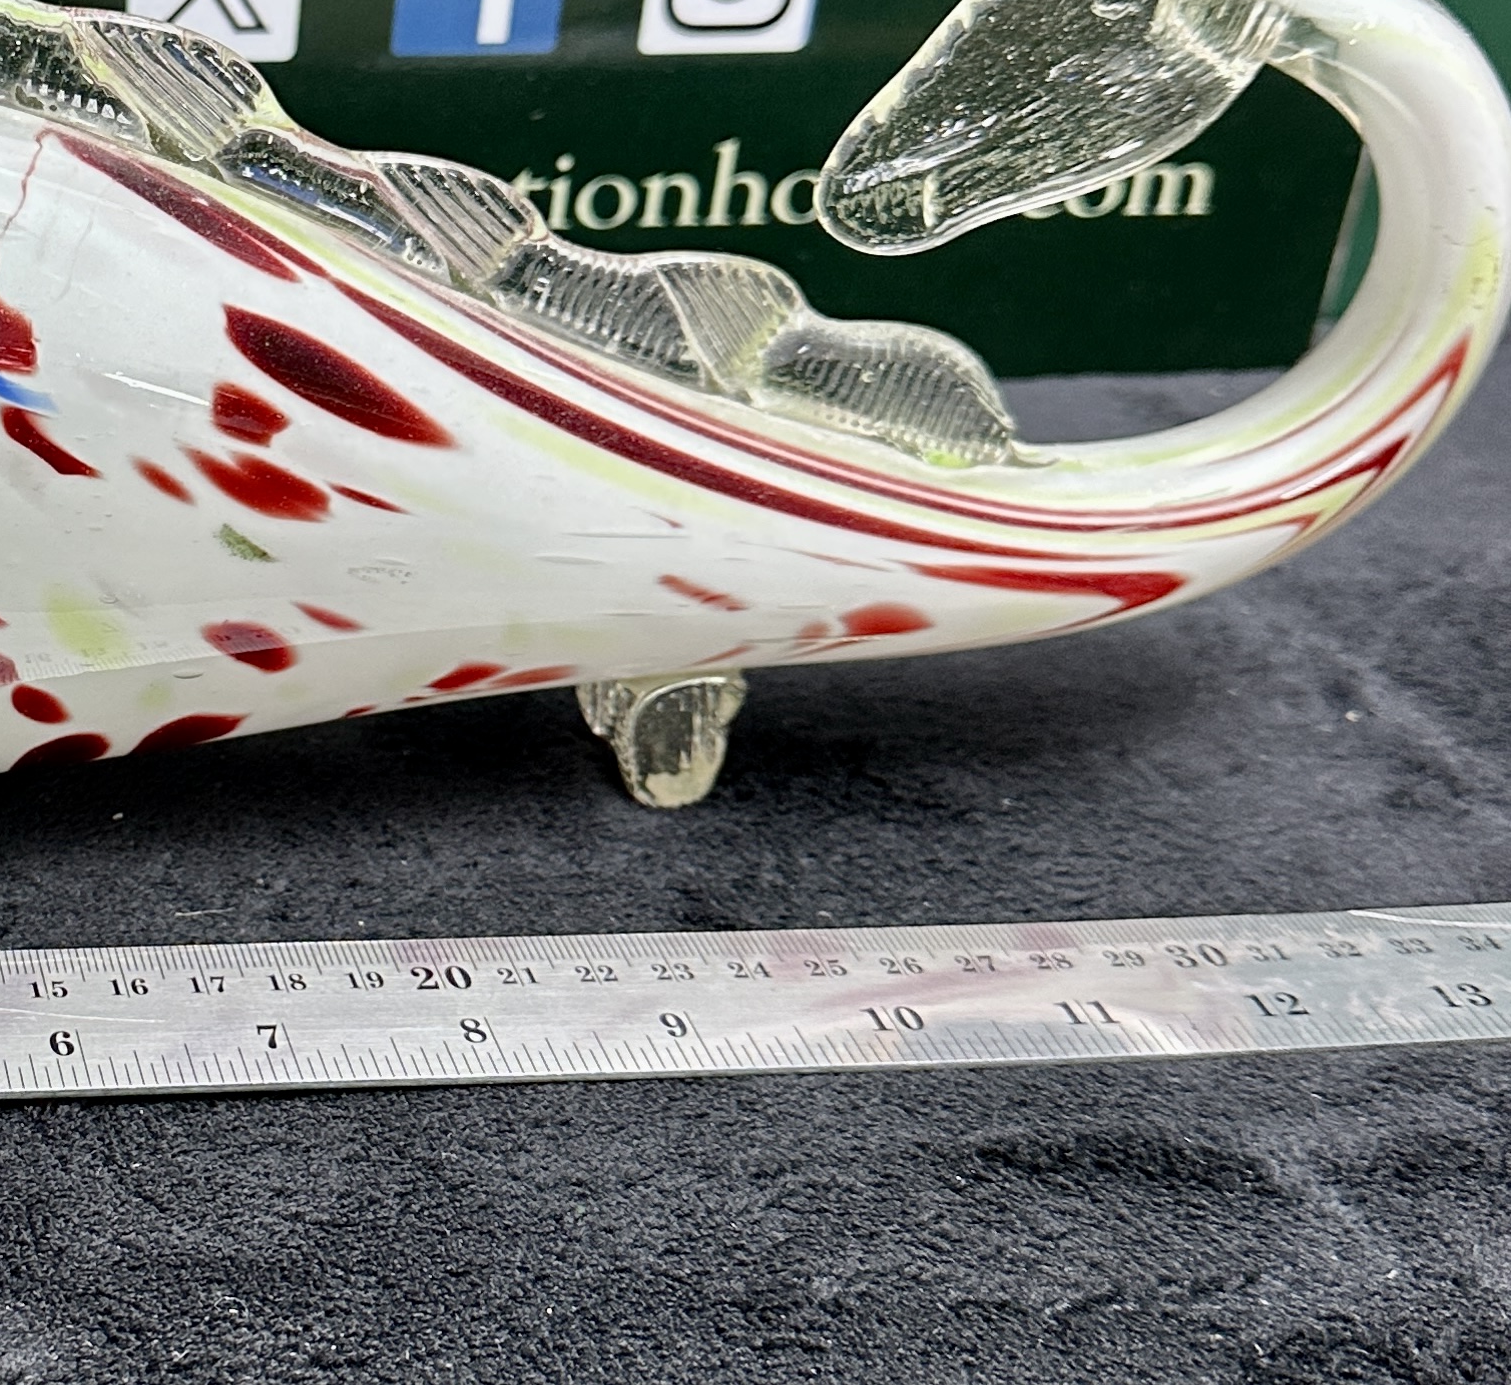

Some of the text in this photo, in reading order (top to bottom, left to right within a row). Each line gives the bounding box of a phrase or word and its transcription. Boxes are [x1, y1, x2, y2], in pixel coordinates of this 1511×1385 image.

[30, 980, 69, 999] 15
[110, 977, 149, 997] 16
[189, 975, 226, 994] 17
[268, 973, 307, 992] 18
[347, 970, 384, 990] 19
[410, 965, 472, 992] 20
[496, 966, 539, 986] 21
[575, 964, 619, 984] 22
[651, 962, 694, 982] 23
[728, 960, 771, 980] 24
[802, 957, 848, 978] 25
[879, 956, 924, 975] 26
[954, 954, 998, 974] 27
[1029, 952, 1073, 971] 28
[1102, 948, 1146, 969] 29
[1165, 943, 1228, 969] 30
[1245, 943, 1290, 962] 31
[1318, 939, 1362, 959] 32
[1389, 937, 1433, 955] 33
[49, 1030, 75, 1057] 6
[256, 1024, 279, 1050] 7
[460, 1018, 488, 1044] 8
[659, 1012, 688, 1038] 9
[859, 1005, 925, 1032] 10
[1054, 999, 1121, 1025] 11
[1243, 991, 1309, 1017] 12
[1429, 983, 1494, 1009] 13
